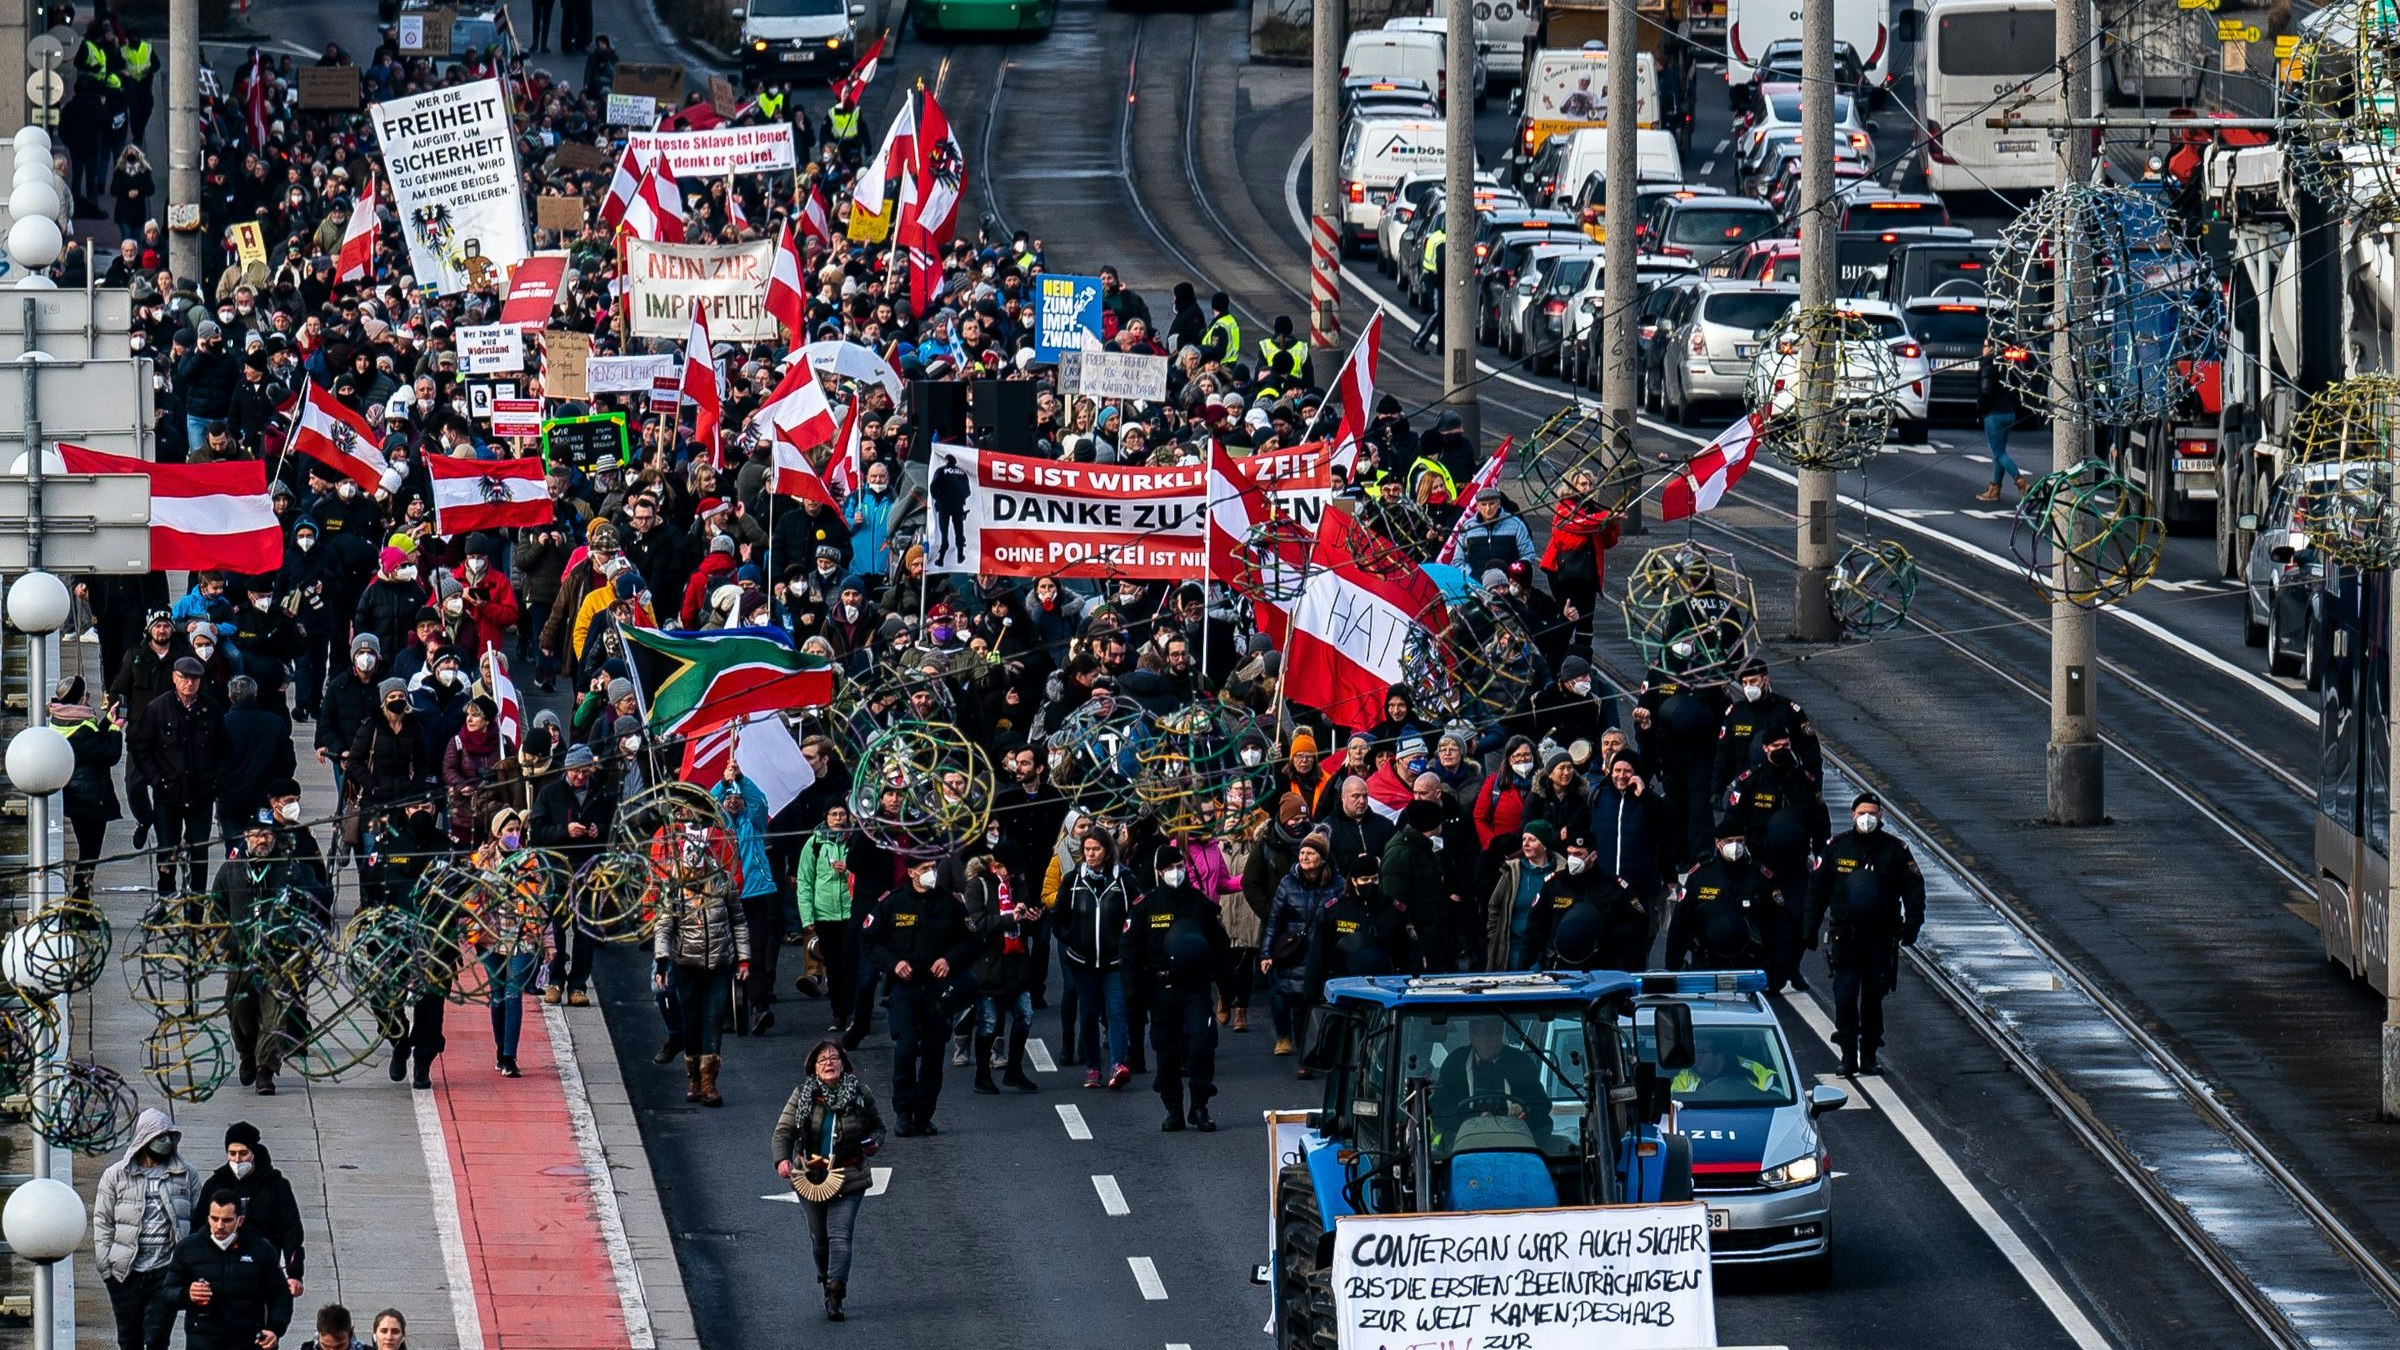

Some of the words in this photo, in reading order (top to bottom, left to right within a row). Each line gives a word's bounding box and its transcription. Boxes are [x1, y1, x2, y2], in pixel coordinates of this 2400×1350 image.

[444, 91, 462, 102] DIE
[383, 98, 496, 141] FREIHEIT
[412, 131, 461, 150] AUFGIBT,
[463, 127, 480, 138] UM
[632, 137, 651, 150] Der
[655, 136, 689, 150] beste
[693, 132, 734, 148] Sklave
[738, 132, 752, 146] ist
[392, 136, 504, 174] SICHERHEIT
[674, 156, 710, 168] denkt
[713, 157, 725, 167] er
[400, 178, 413, 189] ZU
[415, 164, 476, 184] GEWINNEN,
[478, 157, 506, 172] WIRD
[412, 190, 426, 202] AM
[429, 183, 458, 197] ENDE
[461, 173, 500, 190] BEIDES
[648, 252, 707, 280] NEIN
[1043, 279, 1074, 297] NEIN
[1042, 297, 1073, 314] ZUM
[1042, 314, 1082, 331] IMPF-
[1042, 331, 1081, 349] ZWAN
[992, 460, 1024, 483] ES
[1034, 466, 1080, 488] IST
[1255, 453, 1320, 481] ZEIT
[993, 494, 1122, 526] DANKE
[1134, 504, 1184, 530] ZU
[994, 546, 1044, 564] OHNE
[1048, 542, 1144, 566] POLIZEI
[1149, 552, 1176, 567] IST
[1352, 1233, 1511, 1268] CONTERGAN
[1518, 1232, 1570, 1262] WAR
[1579, 1229, 1632, 1258] AUCH
[1636, 1224, 1706, 1256] SICHER
[1344, 1276, 1385, 1299] BIS
[1385, 1277, 1427, 1300] DIE
[1431, 1274, 1513, 1298] ERSTEN
[1514, 1265, 1702, 1297] BEEINTRÄCHTIGTEN
[1358, 1309, 1407, 1332] ZUR
[1416, 1304, 1481, 1332] WELT
[1483, 1332, 1533, 1350] ZUR
